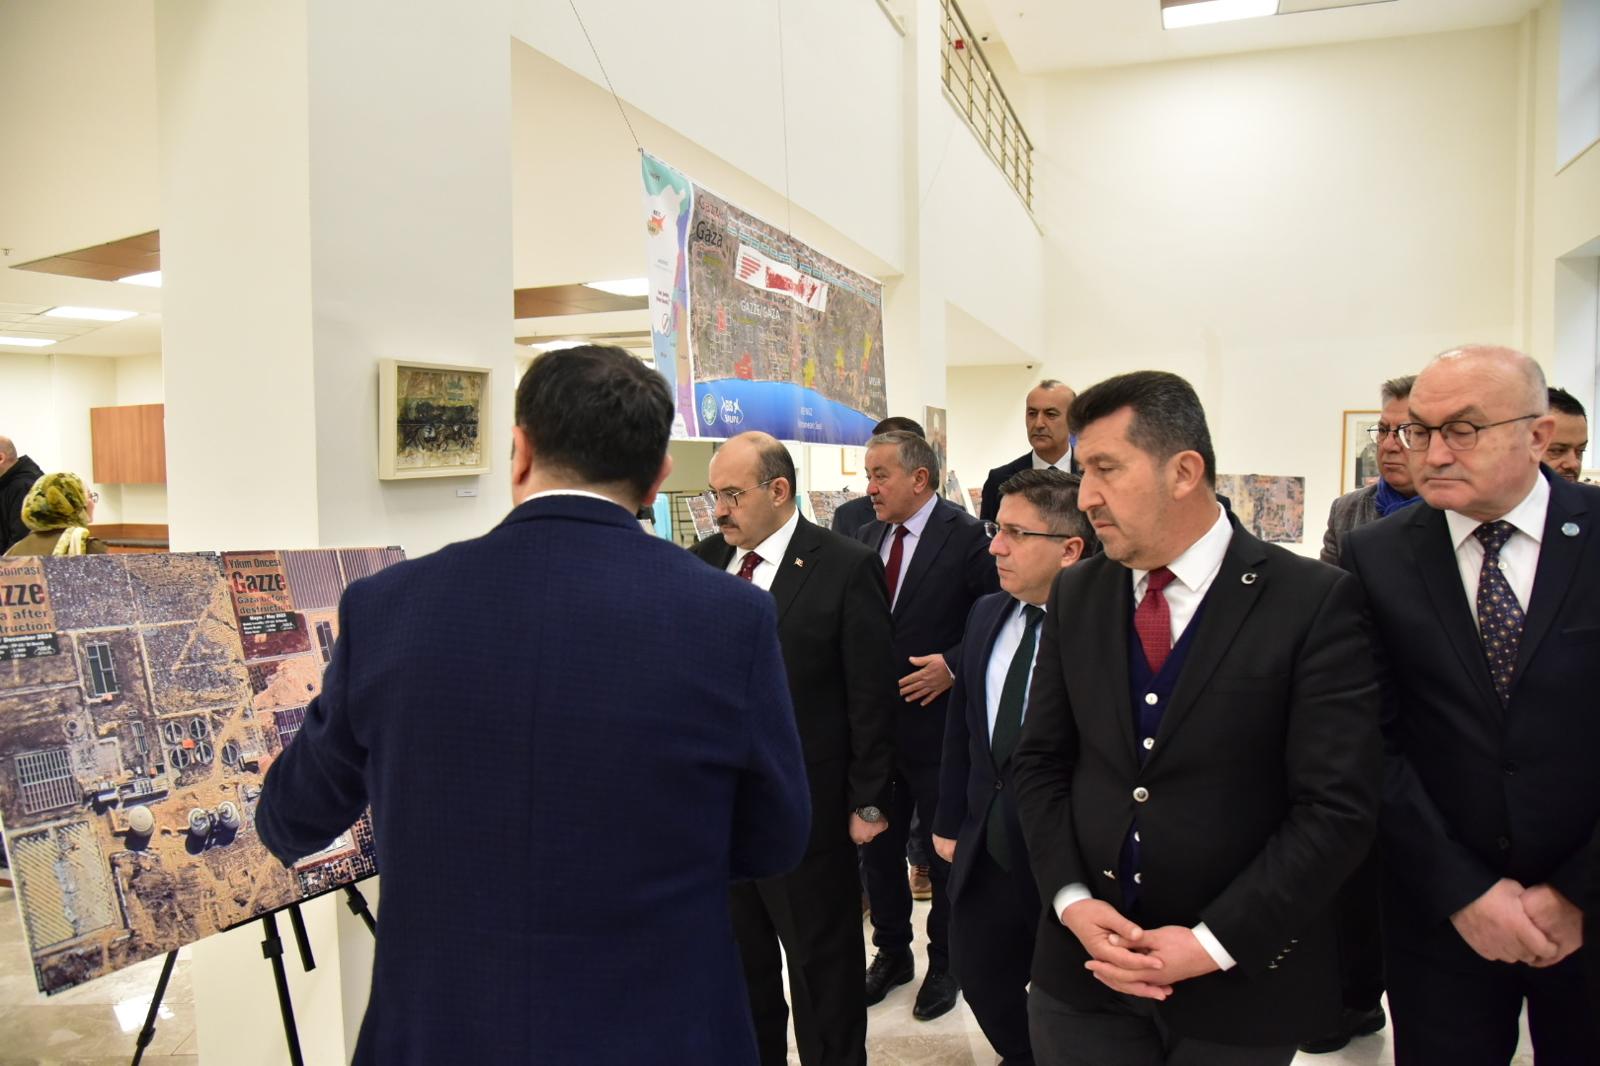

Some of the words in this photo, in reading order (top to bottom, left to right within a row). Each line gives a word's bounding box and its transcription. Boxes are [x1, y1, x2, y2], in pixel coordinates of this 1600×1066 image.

[696, 220, 723, 249] Gaza
[231, 570, 287, 595] Gazze
[0, 583, 46, 607] zze
[13, 609, 48, 620] after
[239, 604, 292, 614] destruction
[0, 622, 52, 634] truction
